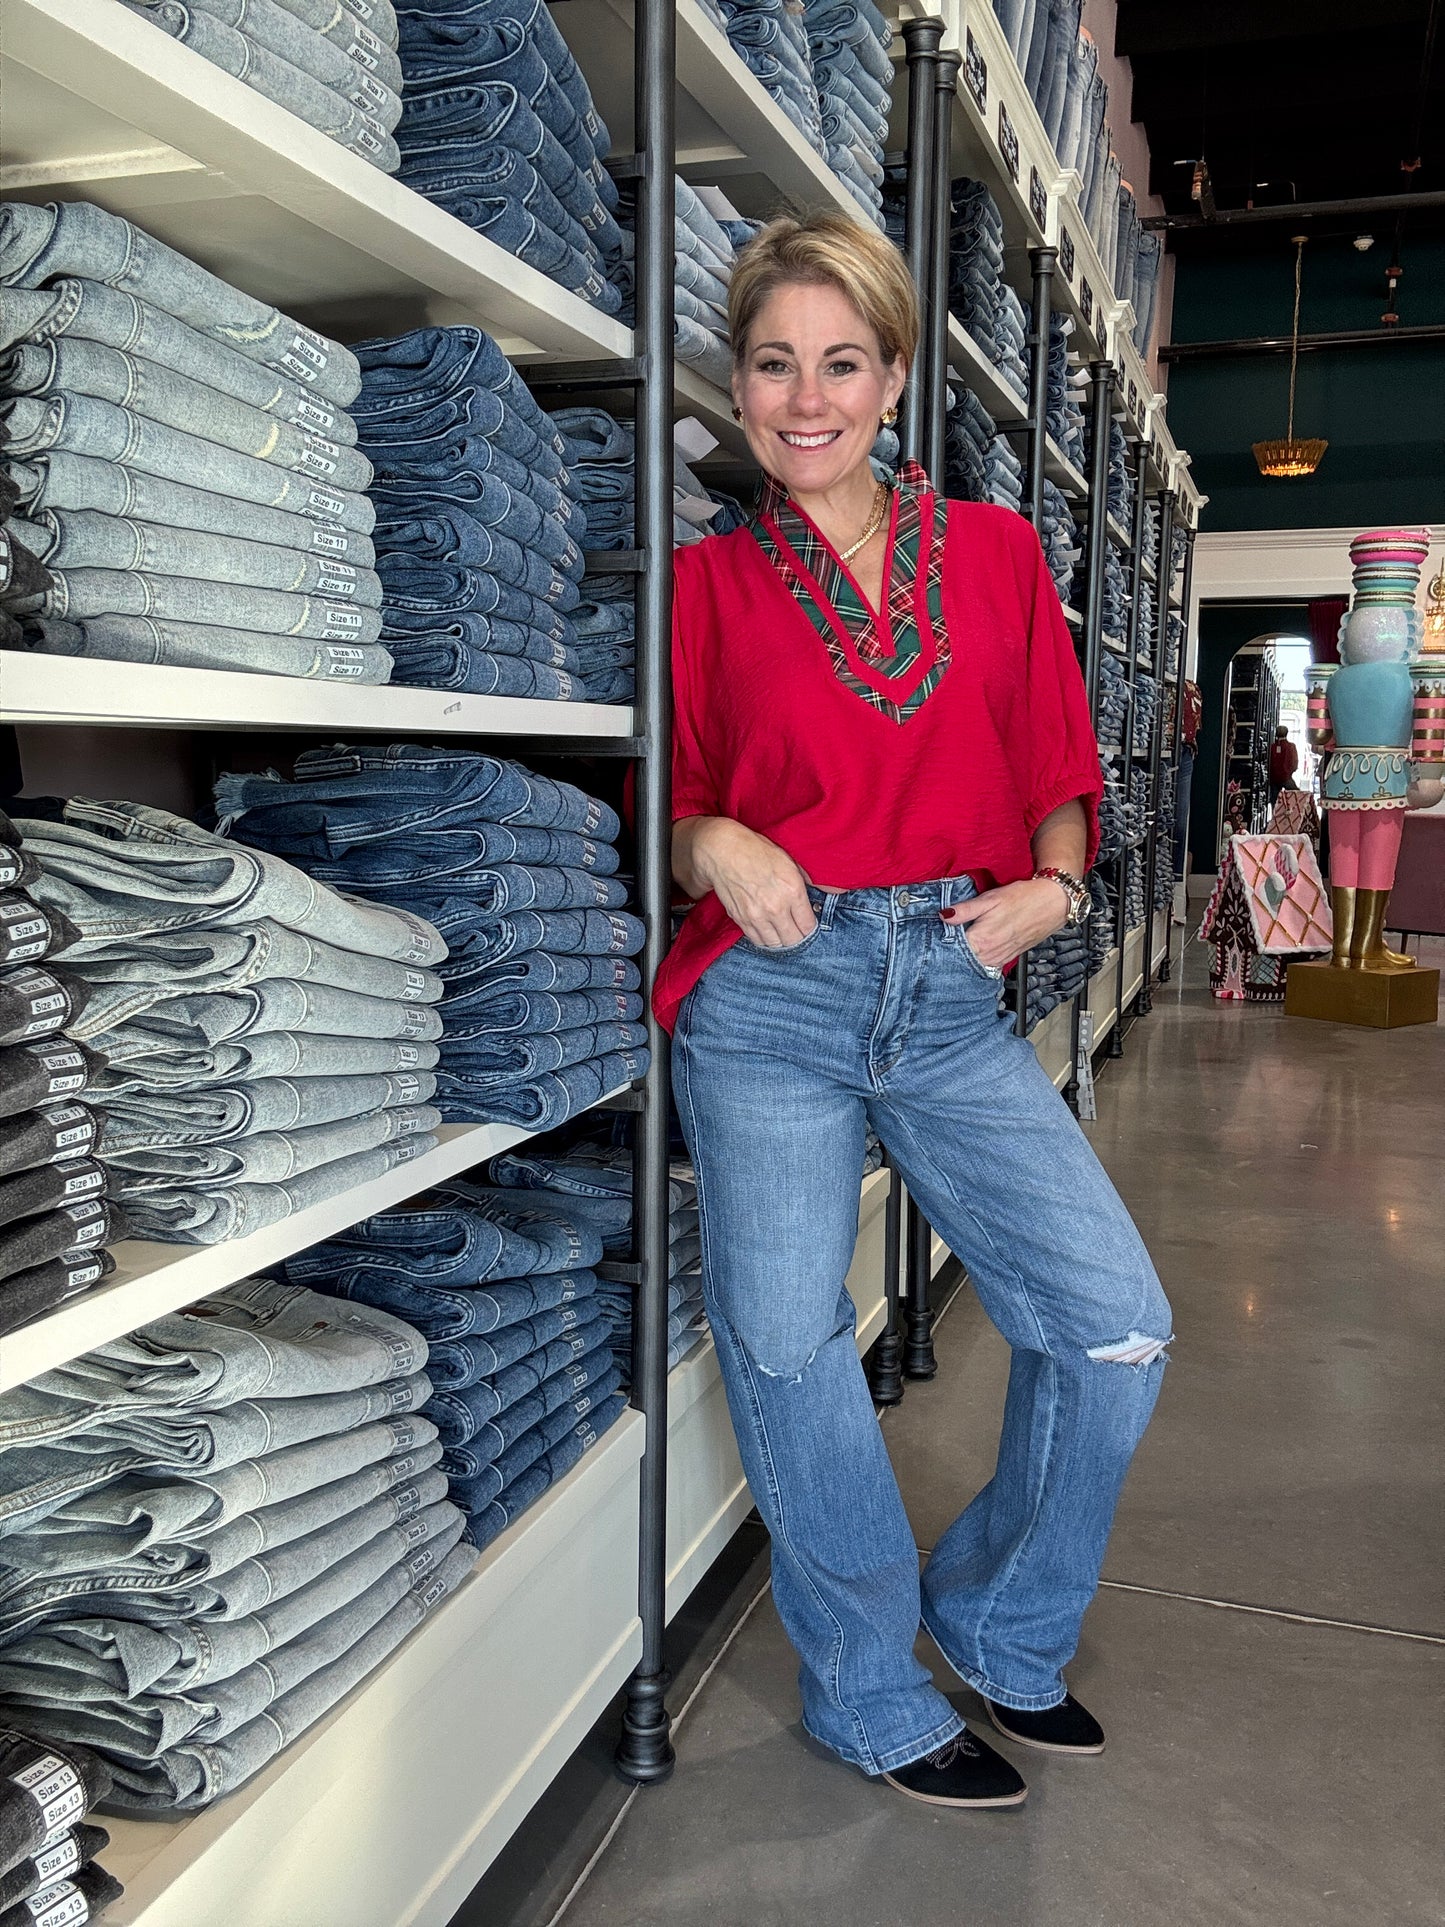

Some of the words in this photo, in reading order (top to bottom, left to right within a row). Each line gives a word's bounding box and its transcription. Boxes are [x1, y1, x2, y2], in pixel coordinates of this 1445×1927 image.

[362, 7, 369, 15] 7
[360, 30, 373, 46] Size
[372, 41, 377, 49] 7
[352, 49, 368, 64] Size
[366, 59, 374, 67] 7
[366, 80, 379, 96] Size
[379, 90, 385, 100] 7
[354, 96, 369, 110] Size
[361, 133, 374, 148] Size
[372, 142, 379, 150] 7
[299, 342, 315, 360] Size
[315, 355, 322, 363] 9
[287, 358, 304, 373] Size
[304, 405, 321, 421] Size
[322, 415, 329, 424] 9
[310, 436, 327, 450] Size
[328, 445, 334, 453] 9
[306, 454, 323, 468] Size
[324, 463, 331, 471] 9
[314, 495, 330, 508] Size
[332, 503, 340, 511] 11
[317, 534, 334, 546] Size
[336, 539, 344, 549] 11
[323, 562, 341, 572] Size
[342, 567, 352, 575] 11
[322, 579, 340, 590] Size
[342, 583, 351, 592] 11
[330, 613, 348, 624] Size
[350, 616, 358, 625] 11
[325, 631, 343, 639] Size
[333, 648, 350, 656] Size
[350, 650, 360, 658] 11
[333, 665, 350, 674] Size
[351, 667, 360, 675] 11
[3, 870, 10, 880] 9
[3, 905, 20, 916] Size
[16, 923, 33, 937] Size
[35, 922, 41, 932] 9
[14, 948, 32, 957] Size
[32, 944, 41, 952] 9
[21, 983, 41, 992] Size
[40, 979, 51, 987] 11
[35, 1001, 51, 1012] Size
[53, 997, 62, 1007] 11
[50, 1018, 60, 1027] 11
[48, 1058, 67, 1068] Size
[68, 1055, 79, 1065] 11
[53, 1079, 70, 1090] Size
[71, 1077, 80, 1086] 11
[51, 1112, 70, 1123] Size
[70, 1108, 82, 1117] 11
[400, 1122, 410, 1131] Size
[61, 1132, 78, 1144] Size
[80, 1127, 88, 1138] 11
[398, 1150, 409, 1159] Size
[70, 1180, 88, 1191] Size
[89, 1174, 98, 1185] 11
[71, 1207, 89, 1219] Size
[89, 1201, 99, 1211] 11
[80, 1229, 95, 1240] Size
[95, 1224, 103, 1233] 11
[63, 1254, 81, 1263] Size
[72, 1272, 88, 1284] Size
[88, 1268, 97, 1278] 11
[396, 1359, 406, 1368] Size
[395, 1464, 406, 1473] Size
[398, 1495, 410, 1504] Size
[408, 1528, 420, 1539] Size
[412, 1559, 424, 1570] Size
[426, 1589, 438, 1603] Size
[21, 1769, 45, 1784] Size
[43, 1760, 58, 1770] 13
[38, 1783, 60, 1800] Size
[60, 1771, 73, 1785] 13
[48, 1803, 68, 1823] Size
[69, 1792, 80, 1807] 13
[41, 1856, 62, 1874] Size
[63, 1846, 74, 1860] 13
[32, 1891, 56, 1909] Size
[56, 1883, 71, 1893] 13
[42, 1911, 67, 1927] Size
[69, 1899, 82, 1914] 13
